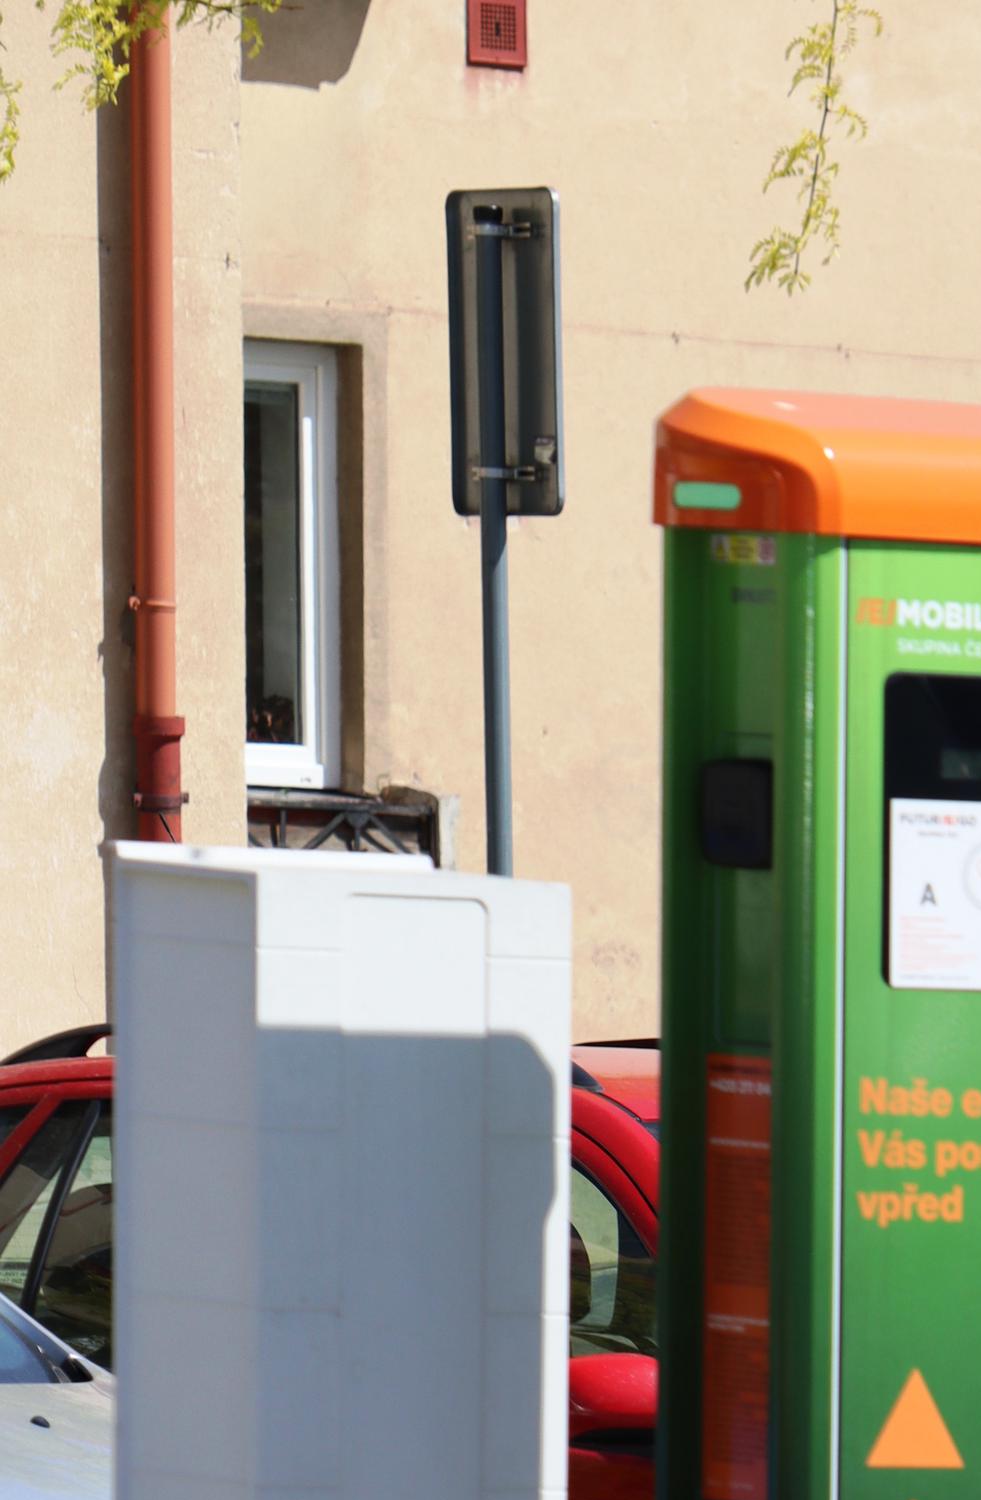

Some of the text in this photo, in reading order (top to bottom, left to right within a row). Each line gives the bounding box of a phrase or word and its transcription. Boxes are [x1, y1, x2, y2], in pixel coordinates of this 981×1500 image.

[897, 637, 961, 657] SKUPINA
[920, 882, 937, 906] A
[859, 1076, 953, 1118] Naše
[857, 1129, 927, 1169] Vás
[856, 1183, 964, 1229] vpřed
